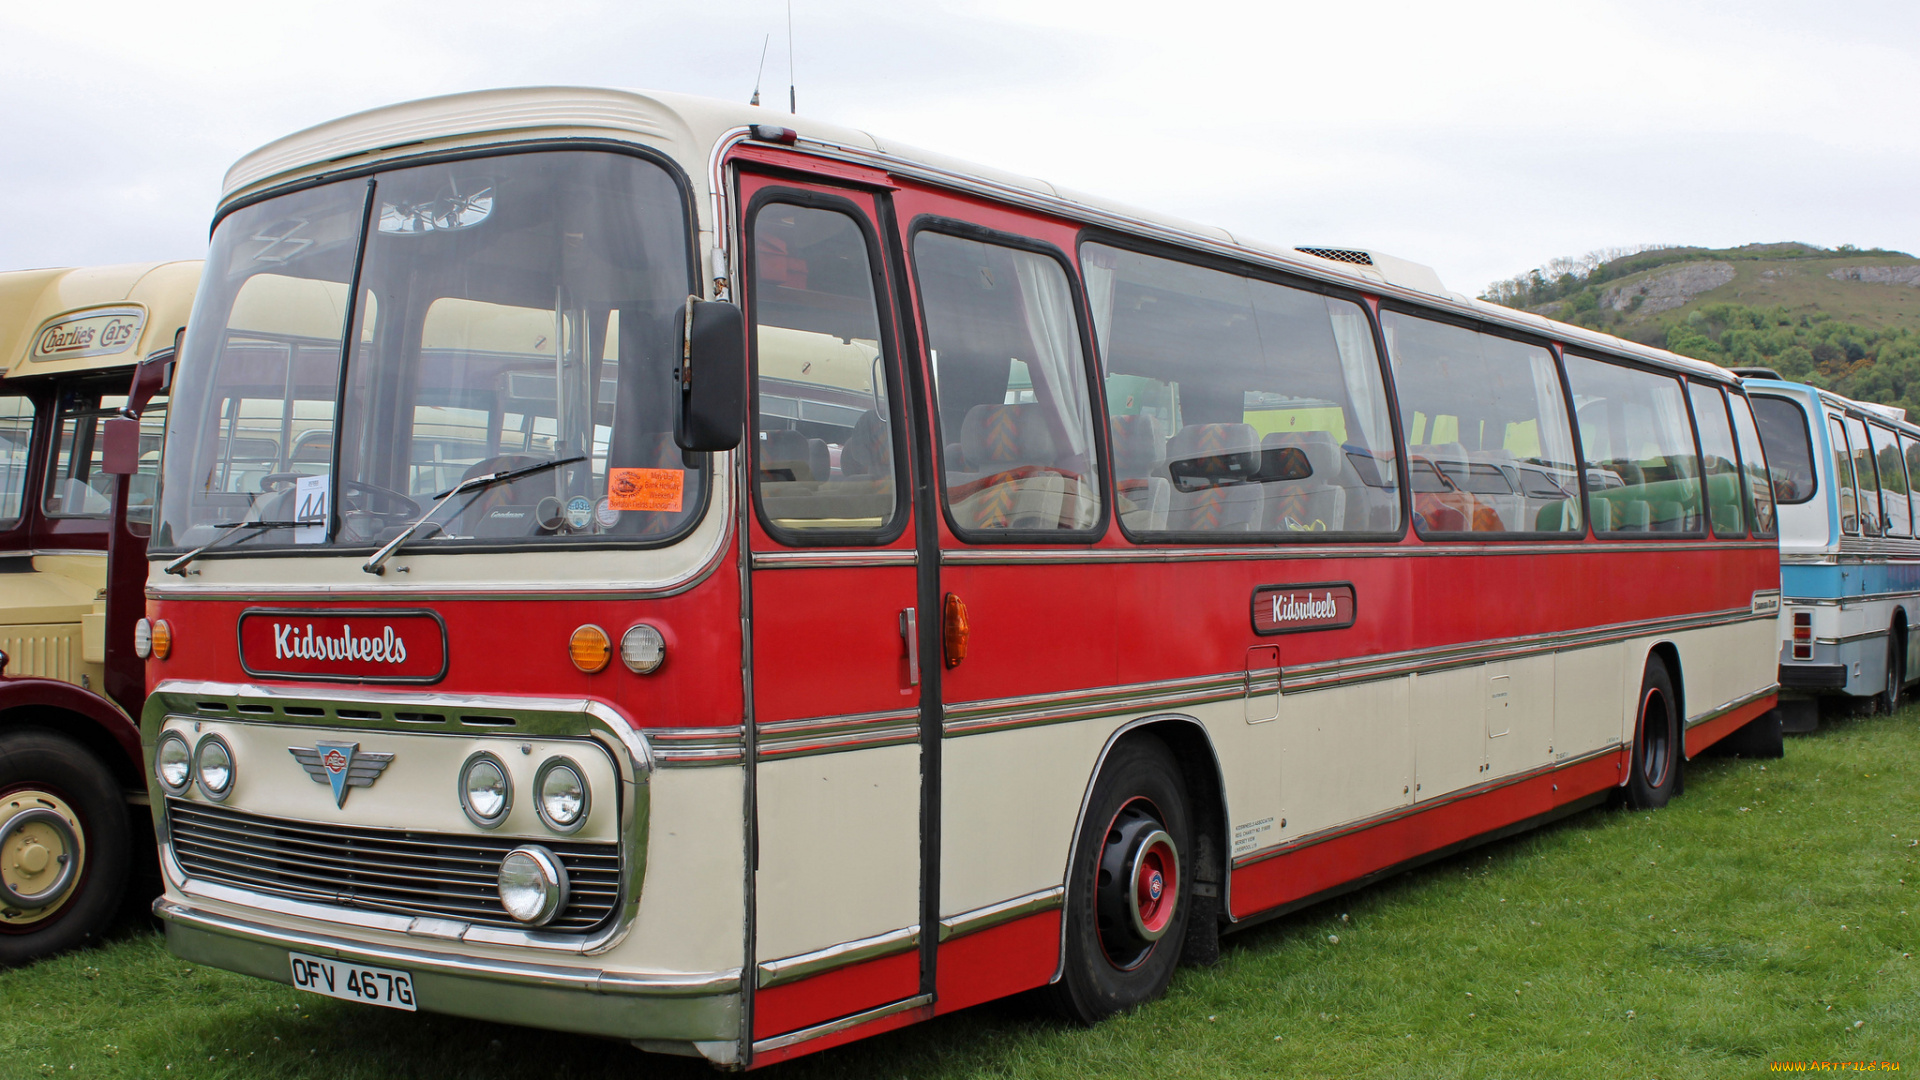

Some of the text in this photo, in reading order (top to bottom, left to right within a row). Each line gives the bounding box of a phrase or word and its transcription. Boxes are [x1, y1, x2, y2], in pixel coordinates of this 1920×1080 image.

[41, 319, 133, 354] Charlie's Cars
[298, 492, 327, 526] 44
[1272, 592, 1337, 623] Kidswheels
[273, 623, 407, 663] Kidswheels
[327, 754, 346, 768] AEC
[292, 958, 414, 1006] OFV 467G
